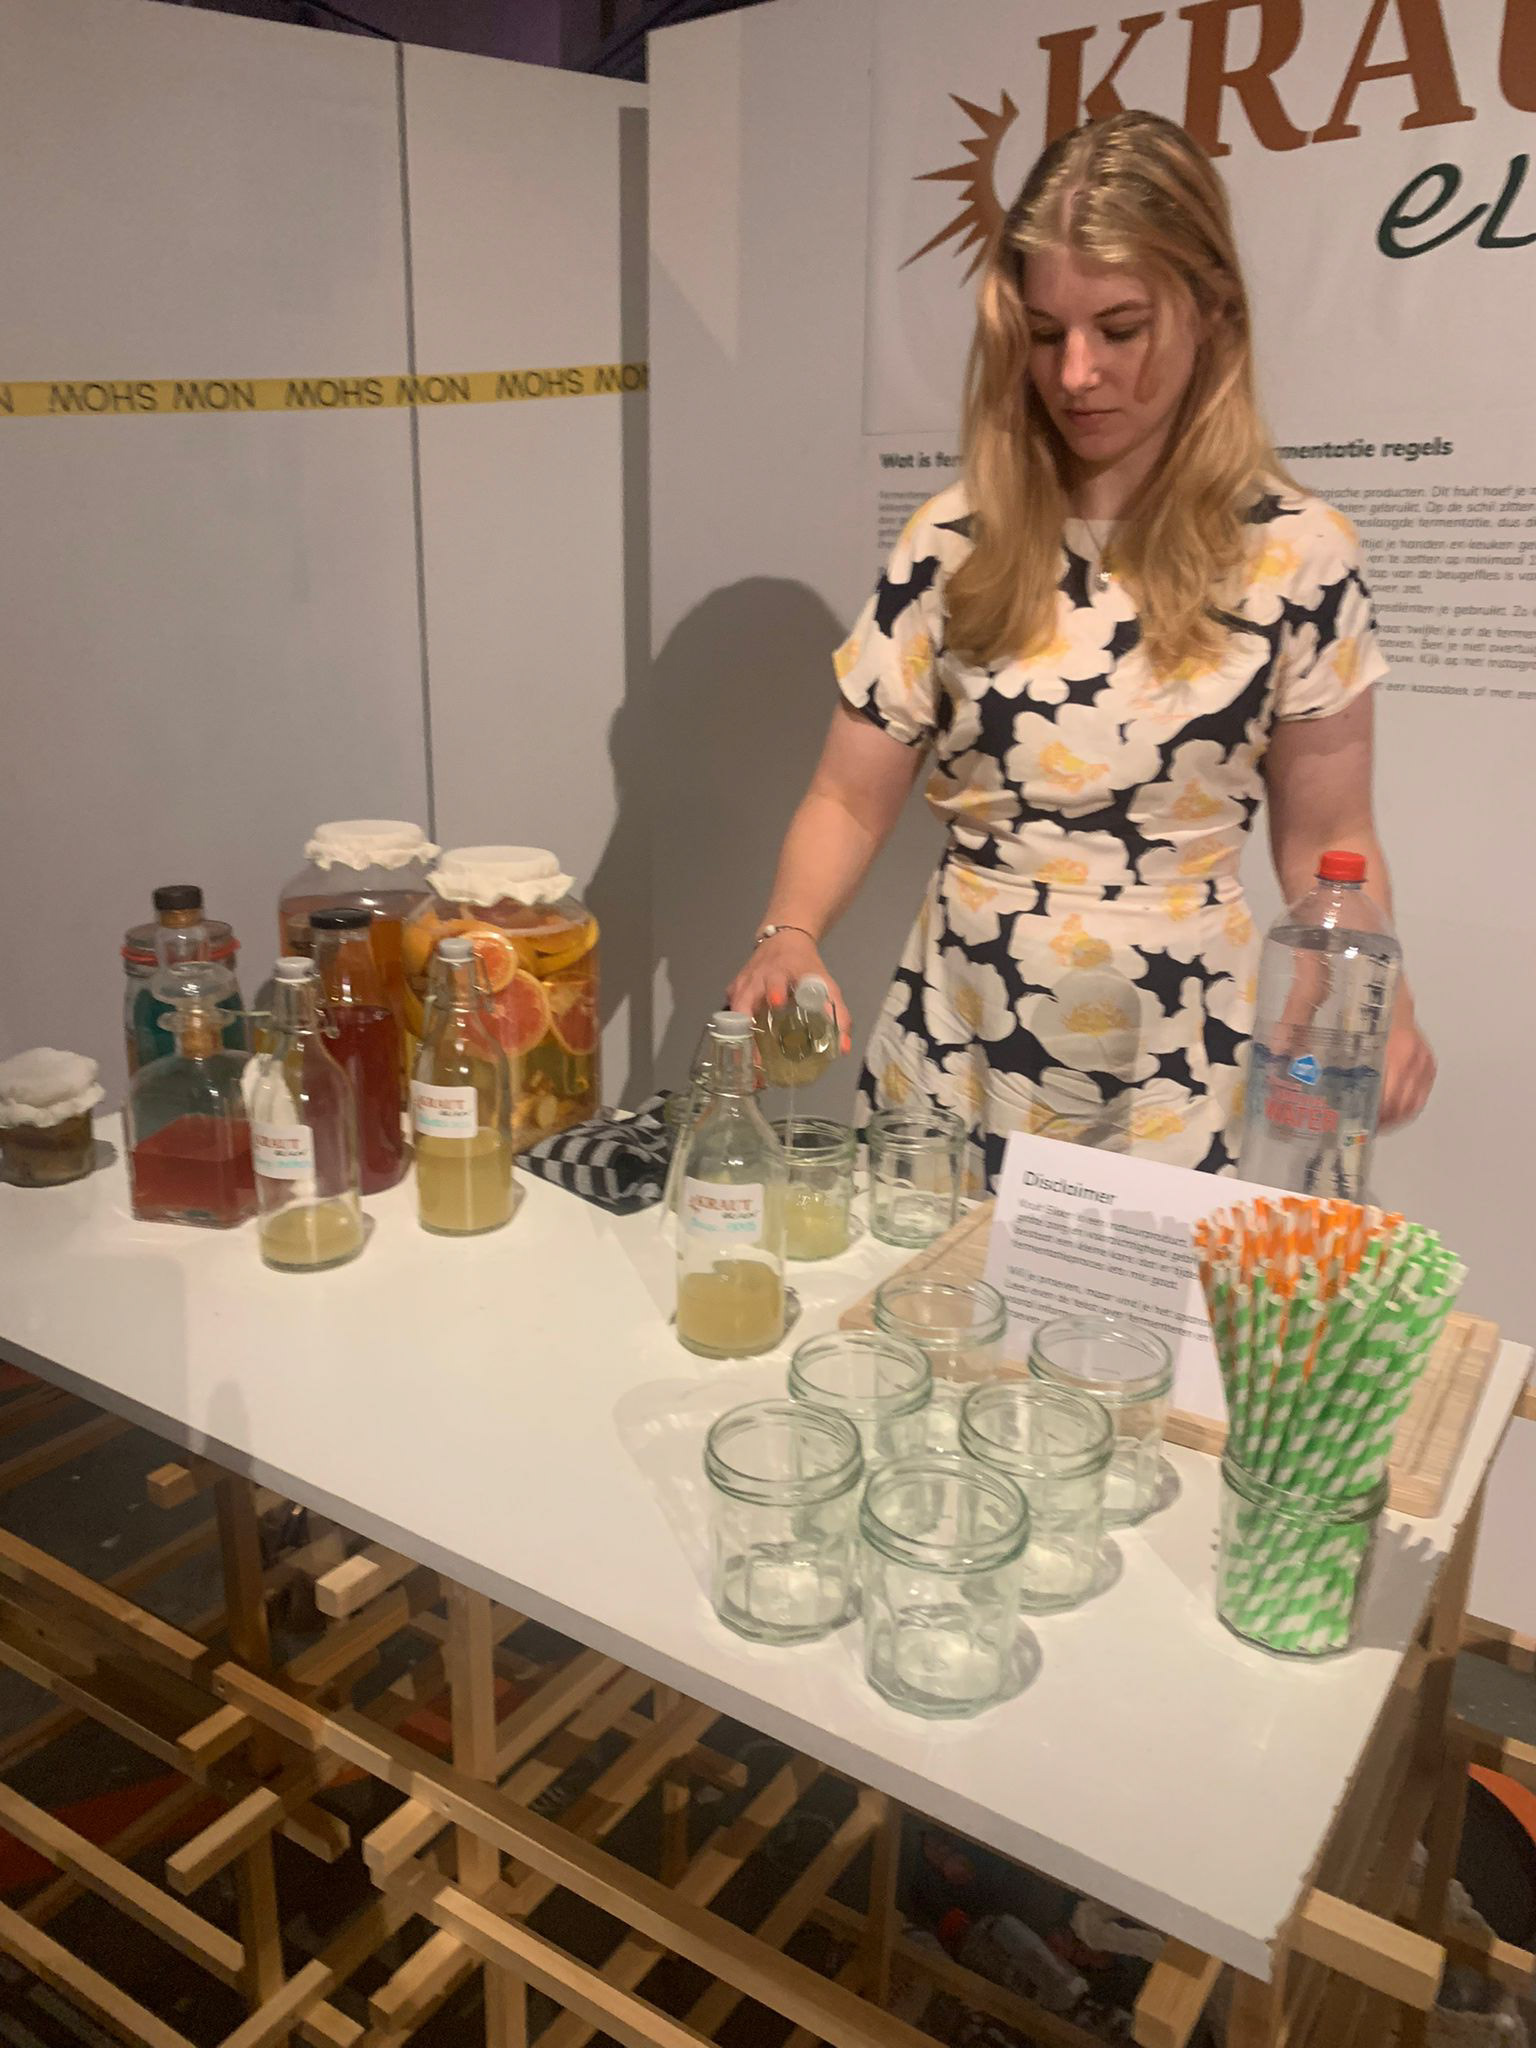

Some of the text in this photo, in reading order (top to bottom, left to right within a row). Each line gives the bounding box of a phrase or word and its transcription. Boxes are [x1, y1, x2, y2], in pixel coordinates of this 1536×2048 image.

[1275, 437, 1453, 461] mentatie regels
[1360, 539, 1381, 551] ltijd
[1021, 1169, 1117, 1205] Disclaimer
